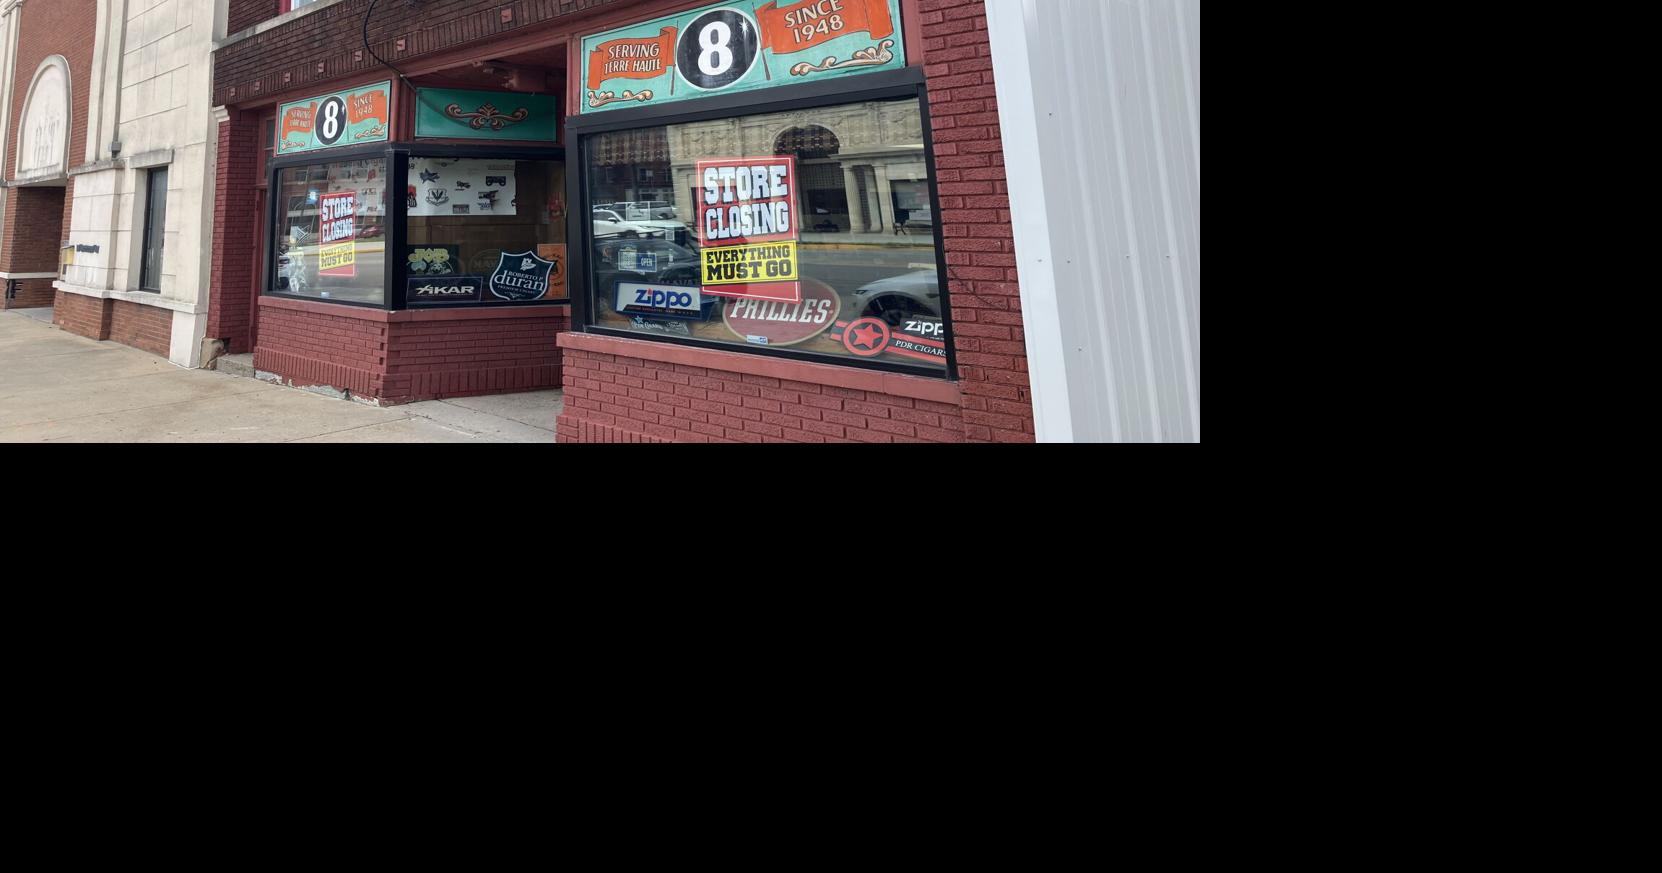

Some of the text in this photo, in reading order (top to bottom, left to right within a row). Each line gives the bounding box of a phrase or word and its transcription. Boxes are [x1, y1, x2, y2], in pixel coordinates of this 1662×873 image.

[784, 0, 843, 28] SINCE
[793, 14, 844, 43] 1948
[608, 43, 660, 60] SERVING
[697, 21, 733, 76] 8
[604, 58, 661, 74] TERRE HAUTE
[354, 94, 373, 109] SINCE
[355, 105, 373, 118] 1948
[323, 101, 338, 139] 8
[703, 164, 788, 206] STORE
[322, 196, 354, 222] STORE
[322, 217, 353, 243] CLOSING
[705, 200, 790, 241] CLOSING
[321, 252, 353, 268] MUST GO
[640, 257, 653, 267] OPEN
[706, 245, 791, 264] EVERYTHING
[494, 269, 545, 291] duran
[507, 270, 538, 281] ROBERTO
[707, 259, 792, 281] MUST GO
[730, 297, 831, 324] PHILLIES
[895, 340, 913, 350] PDR
